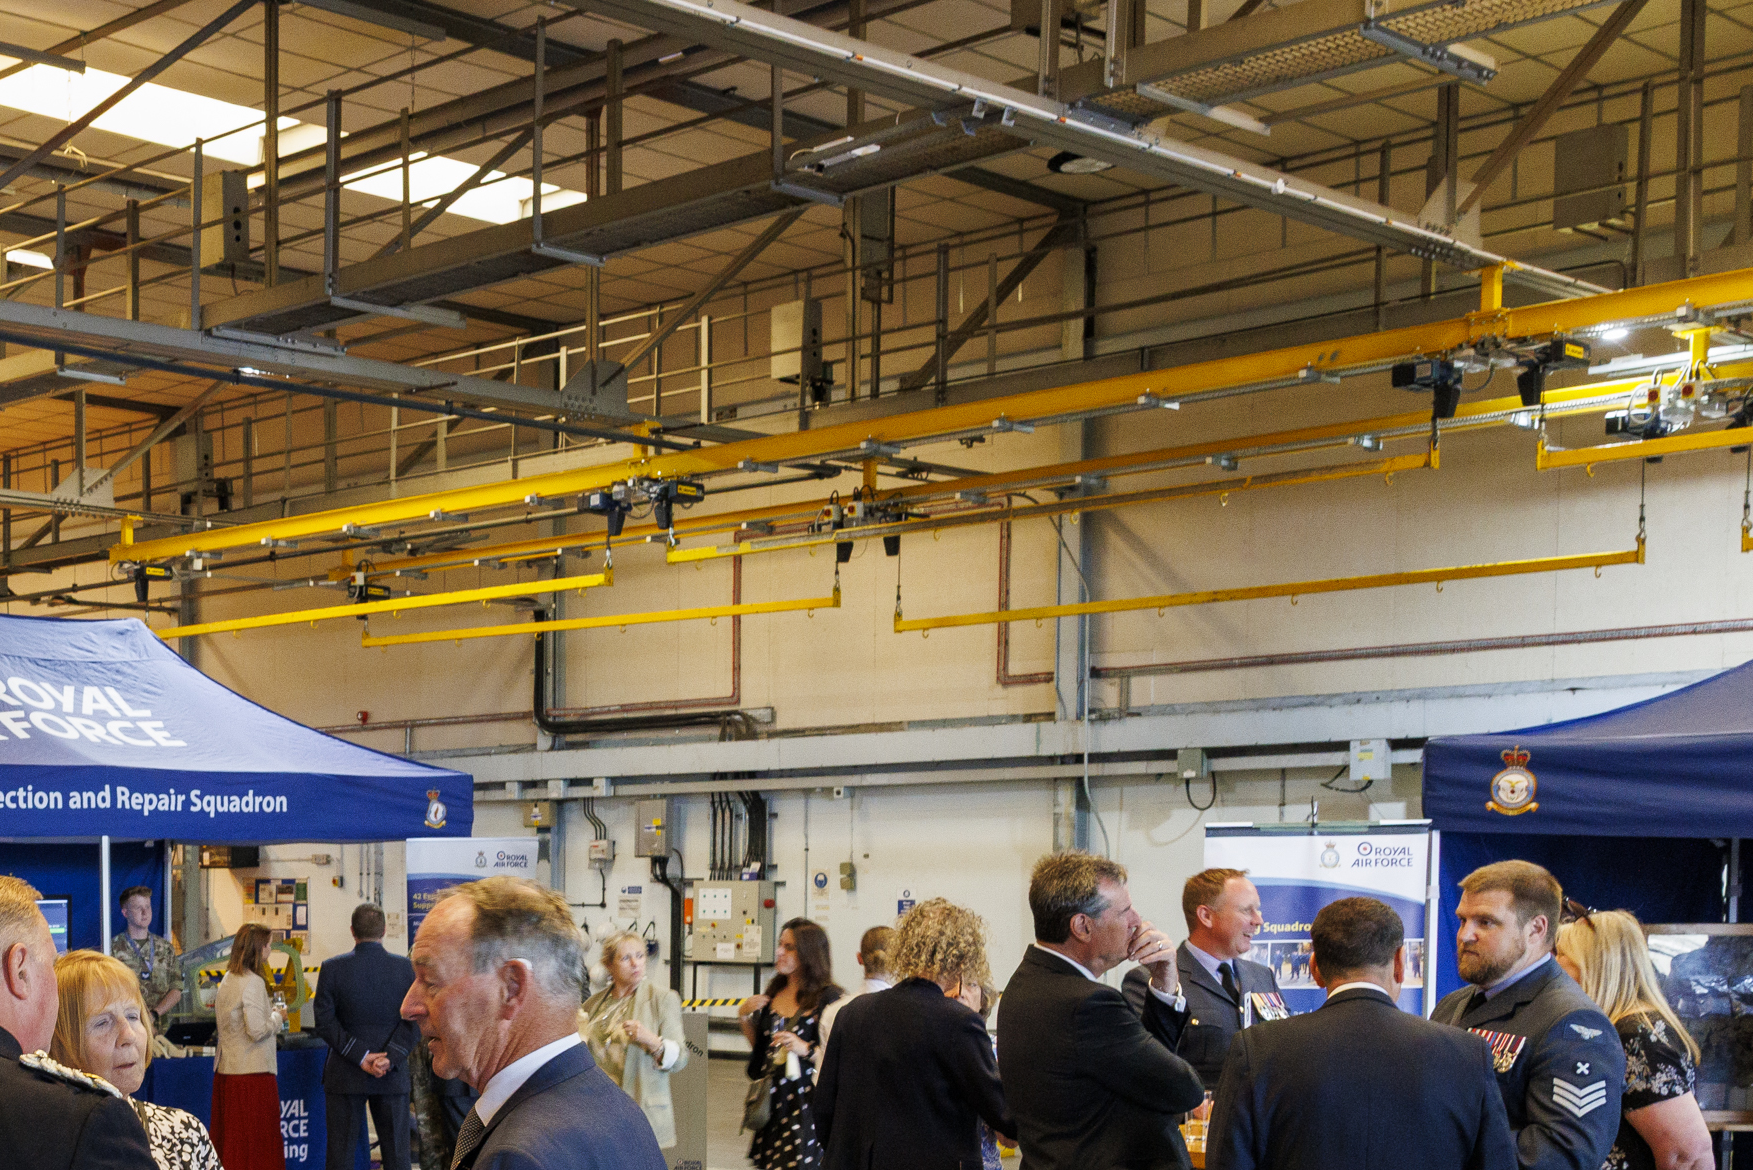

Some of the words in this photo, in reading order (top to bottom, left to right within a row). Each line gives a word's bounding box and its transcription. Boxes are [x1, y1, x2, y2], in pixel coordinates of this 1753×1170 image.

[68, 784, 111, 810] and
[116, 786, 186, 816] Repair
[190, 789, 288, 818] Squadron
[1374, 847, 1413, 857] ROYAL
[1351, 858, 1372, 868] AIR
[1374, 857, 1413, 868] FORCE
[1263, 921, 1312, 934] Squadro
[280, 1099, 309, 1119] YAL
[280, 1119, 308, 1138] RCE
